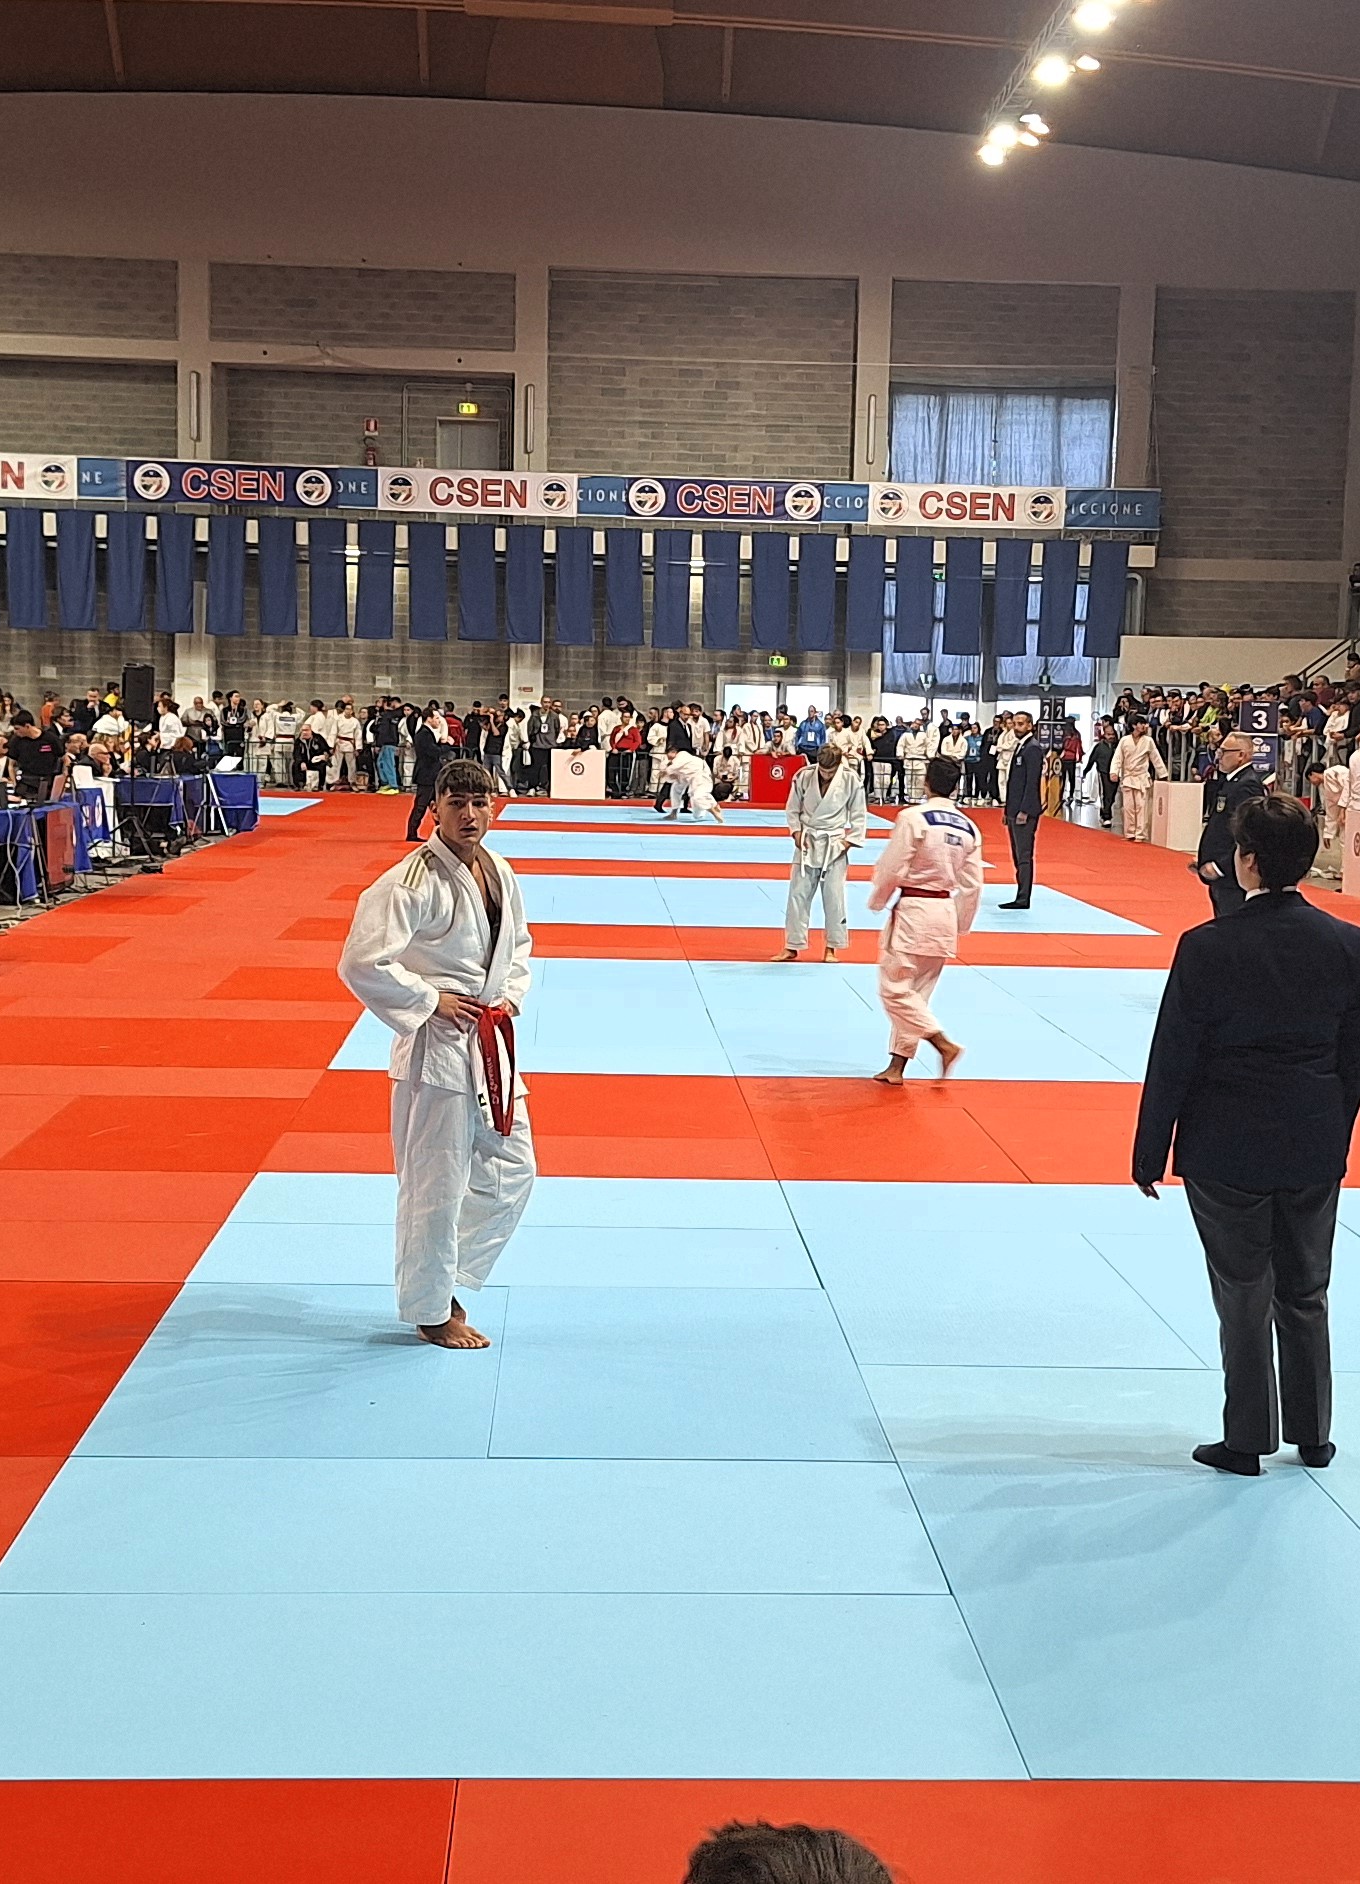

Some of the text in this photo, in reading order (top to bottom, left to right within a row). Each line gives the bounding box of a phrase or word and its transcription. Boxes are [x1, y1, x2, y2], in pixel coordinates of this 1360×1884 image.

[181, 466, 286, 502] CSEN
[428, 476, 528, 509] CSEN
[676, 482, 775, 516] CSEN
[918, 490, 1016, 522] CSEN
[1043, 705, 1049, 720] 2
[1056, 705, 1063, 720] 2
[1251, 709, 1268, 730] 3
